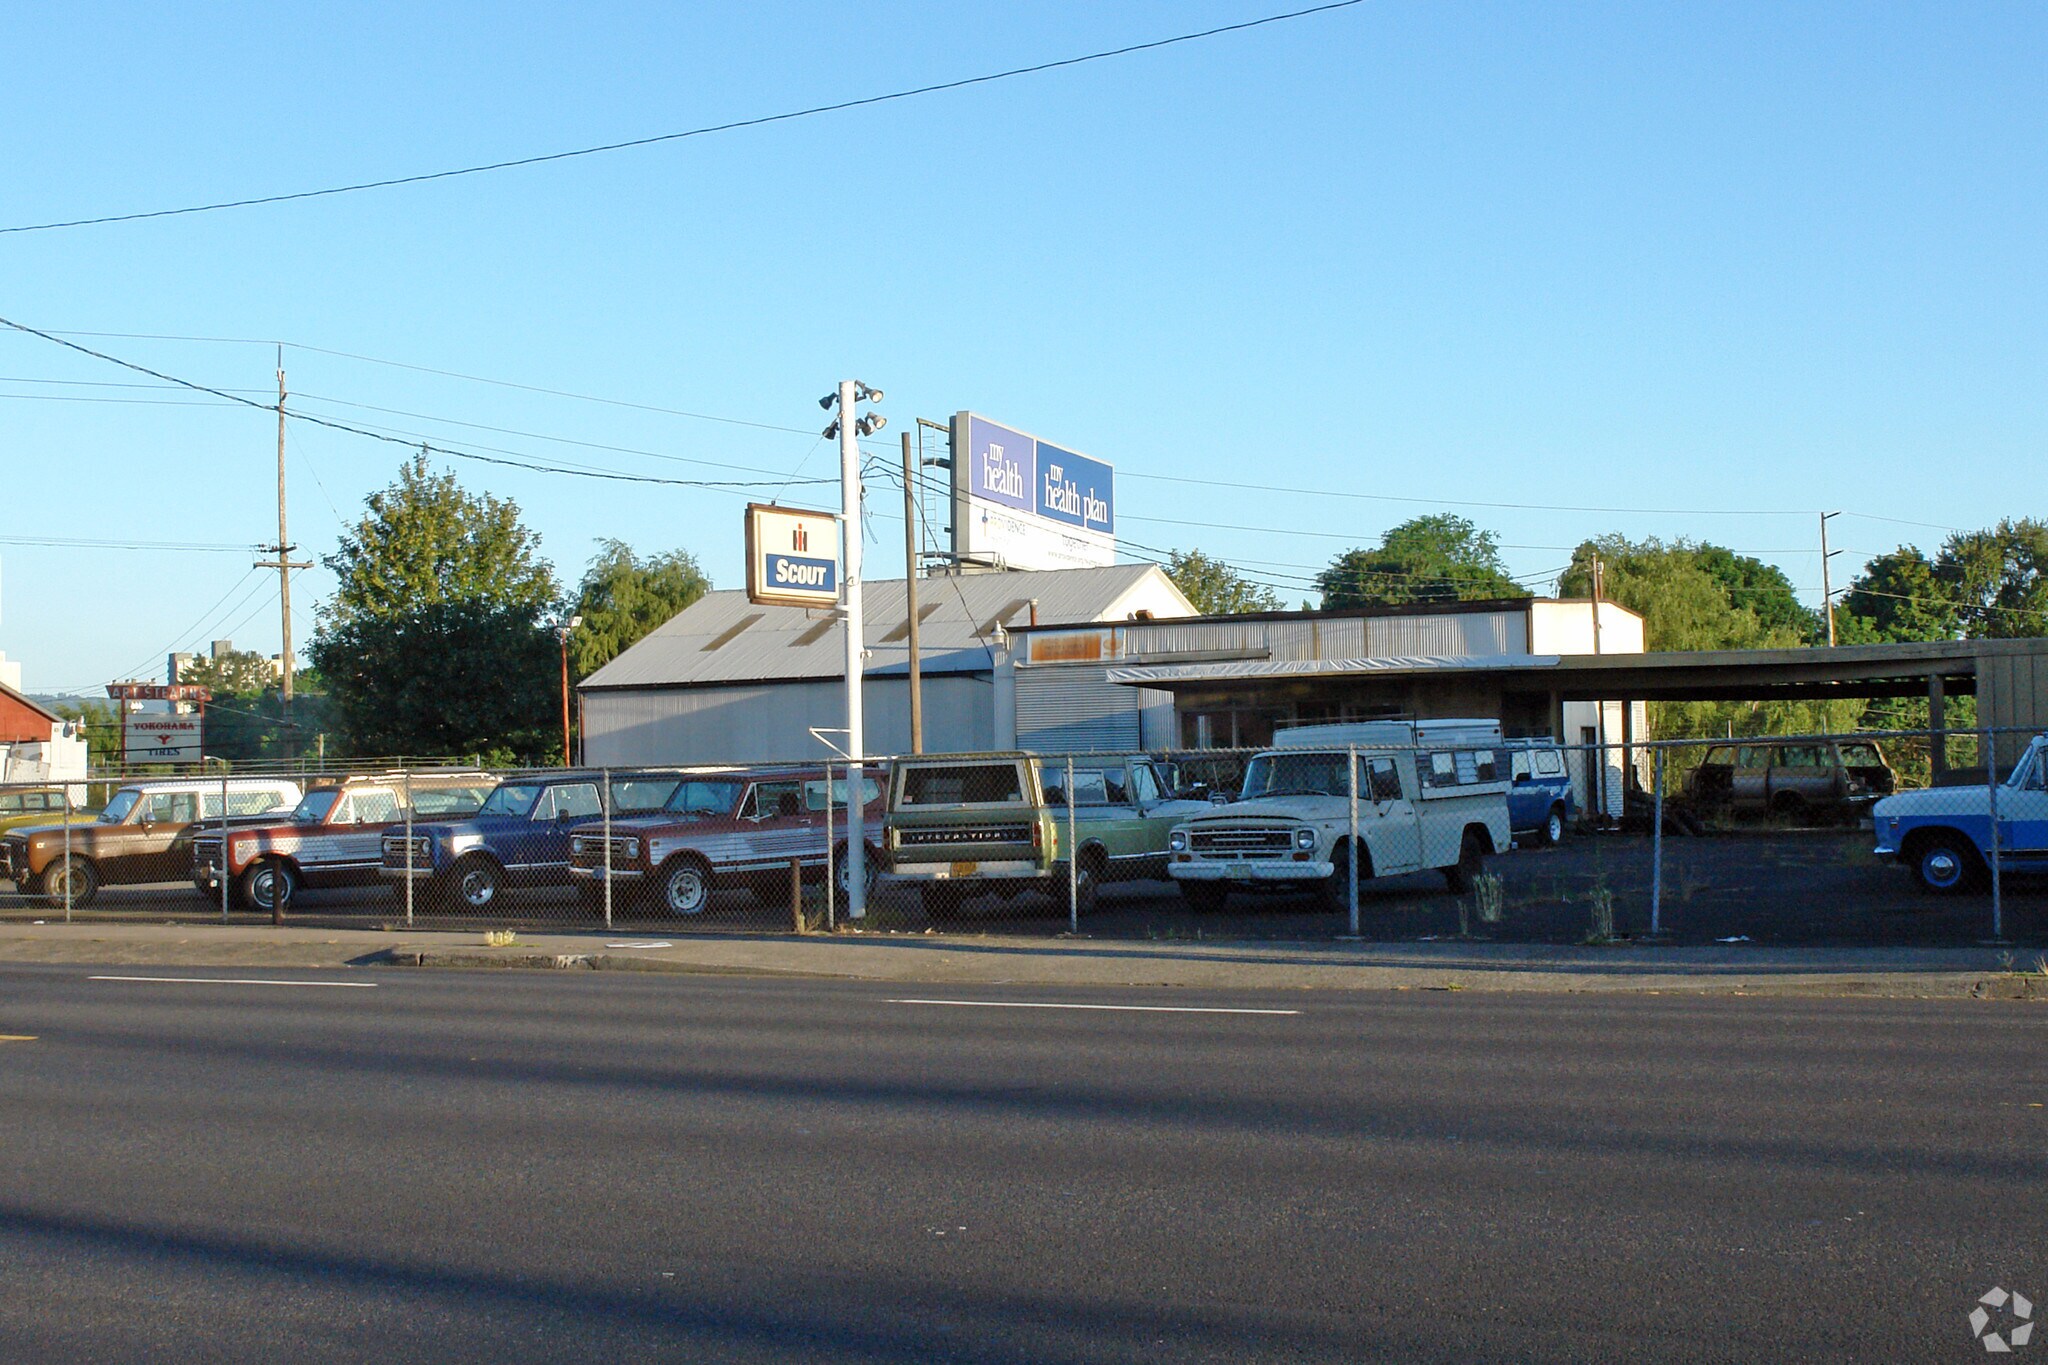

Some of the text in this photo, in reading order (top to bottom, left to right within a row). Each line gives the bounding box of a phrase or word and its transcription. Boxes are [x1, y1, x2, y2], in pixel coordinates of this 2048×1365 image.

[989, 443, 1004, 471] my
[983, 453, 1024, 499] health
[1050, 464, 1064, 488] my
[1045, 473, 1108, 527] health plan
[990, 516, 1026, 536] DENCE
[112, 686, 207, 699] ART STEARNS
[133, 722, 195, 731] YOKOHAMA
[148, 747, 180, 756] TIRES
